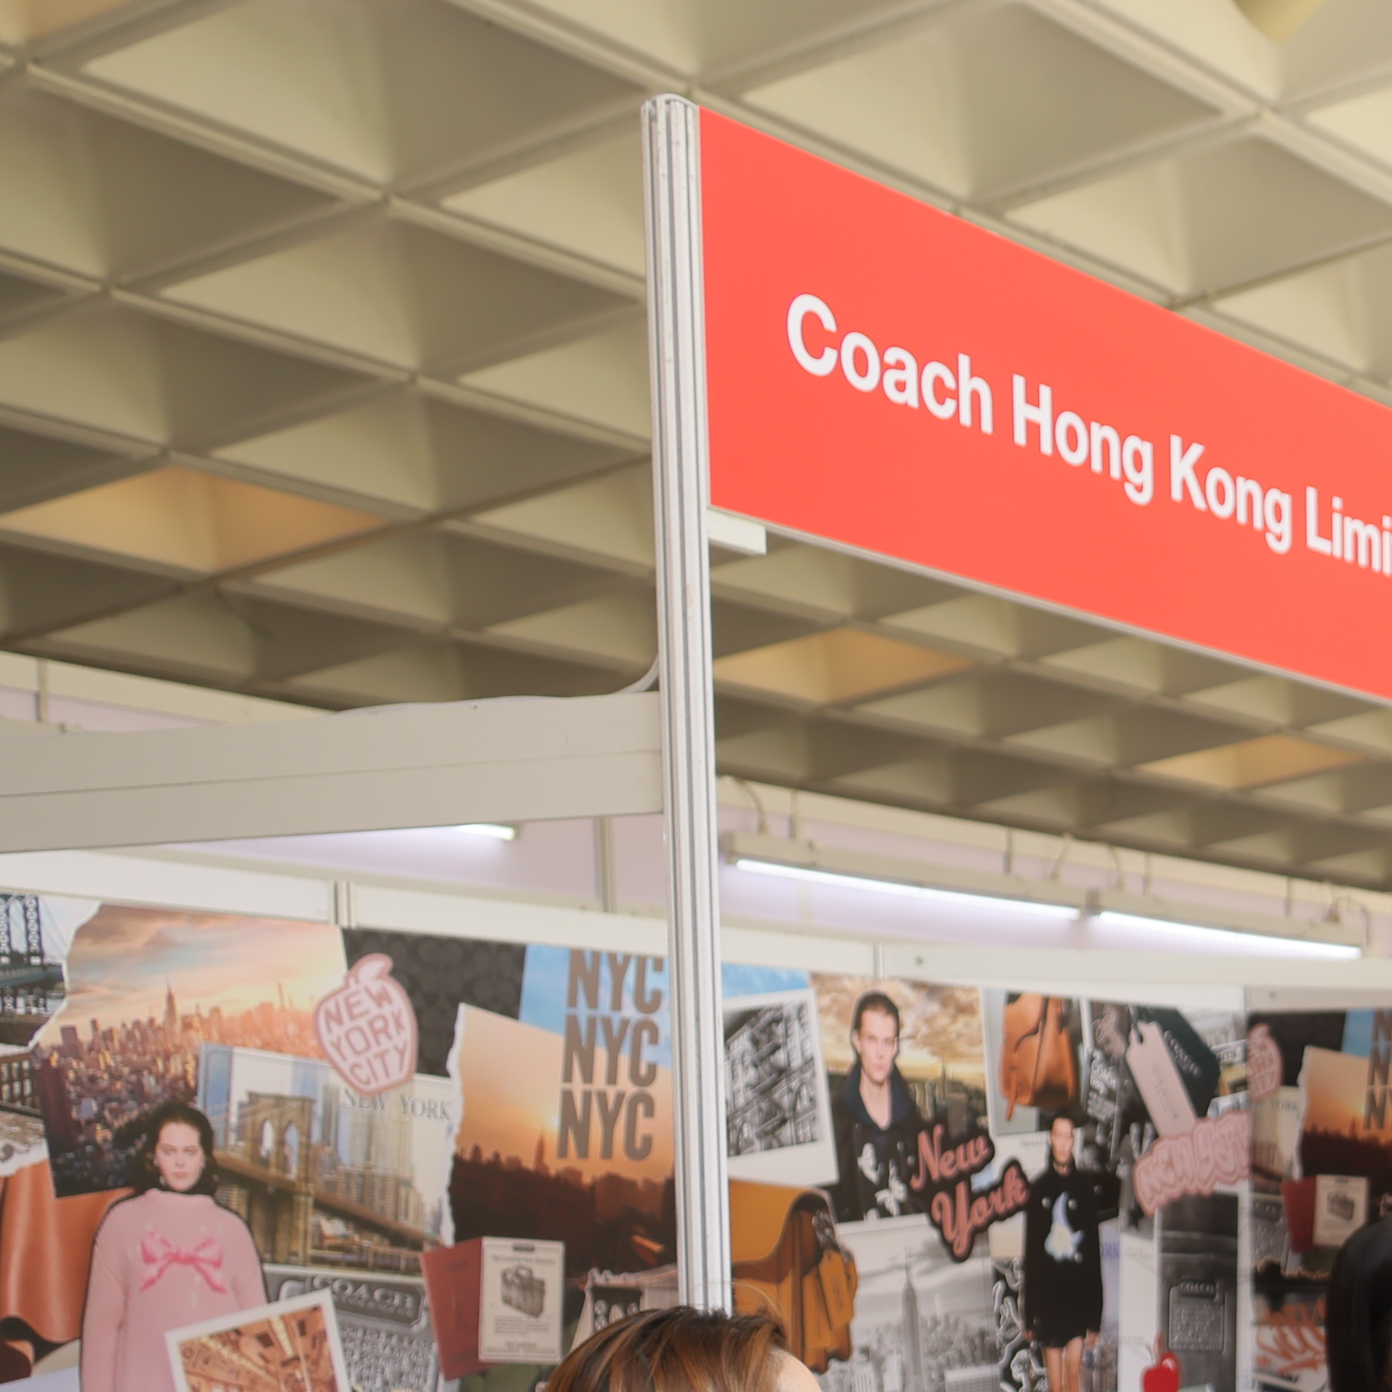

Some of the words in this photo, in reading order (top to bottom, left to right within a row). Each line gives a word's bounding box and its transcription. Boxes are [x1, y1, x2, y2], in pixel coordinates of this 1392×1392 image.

[786, 294, 993, 434] Coach
[1012, 374, 1154, 505] Hong
[1170, 433, 1293, 554] Kong
[324, 985, 392, 1034] NEW
[566, 948, 664, 1014] NYC
[330, 1009, 404, 1061] YORK
[350, 1039, 408, 1085] CITY
[561, 1014, 659, 1087] NYC
[343, 1087, 389, 1110] NEW
[400, 1094, 452, 1120] YORK
[556, 1088, 654, 1161] NYC
[910, 1124, 989, 1191] New
[931, 1165, 1029, 1257] York
